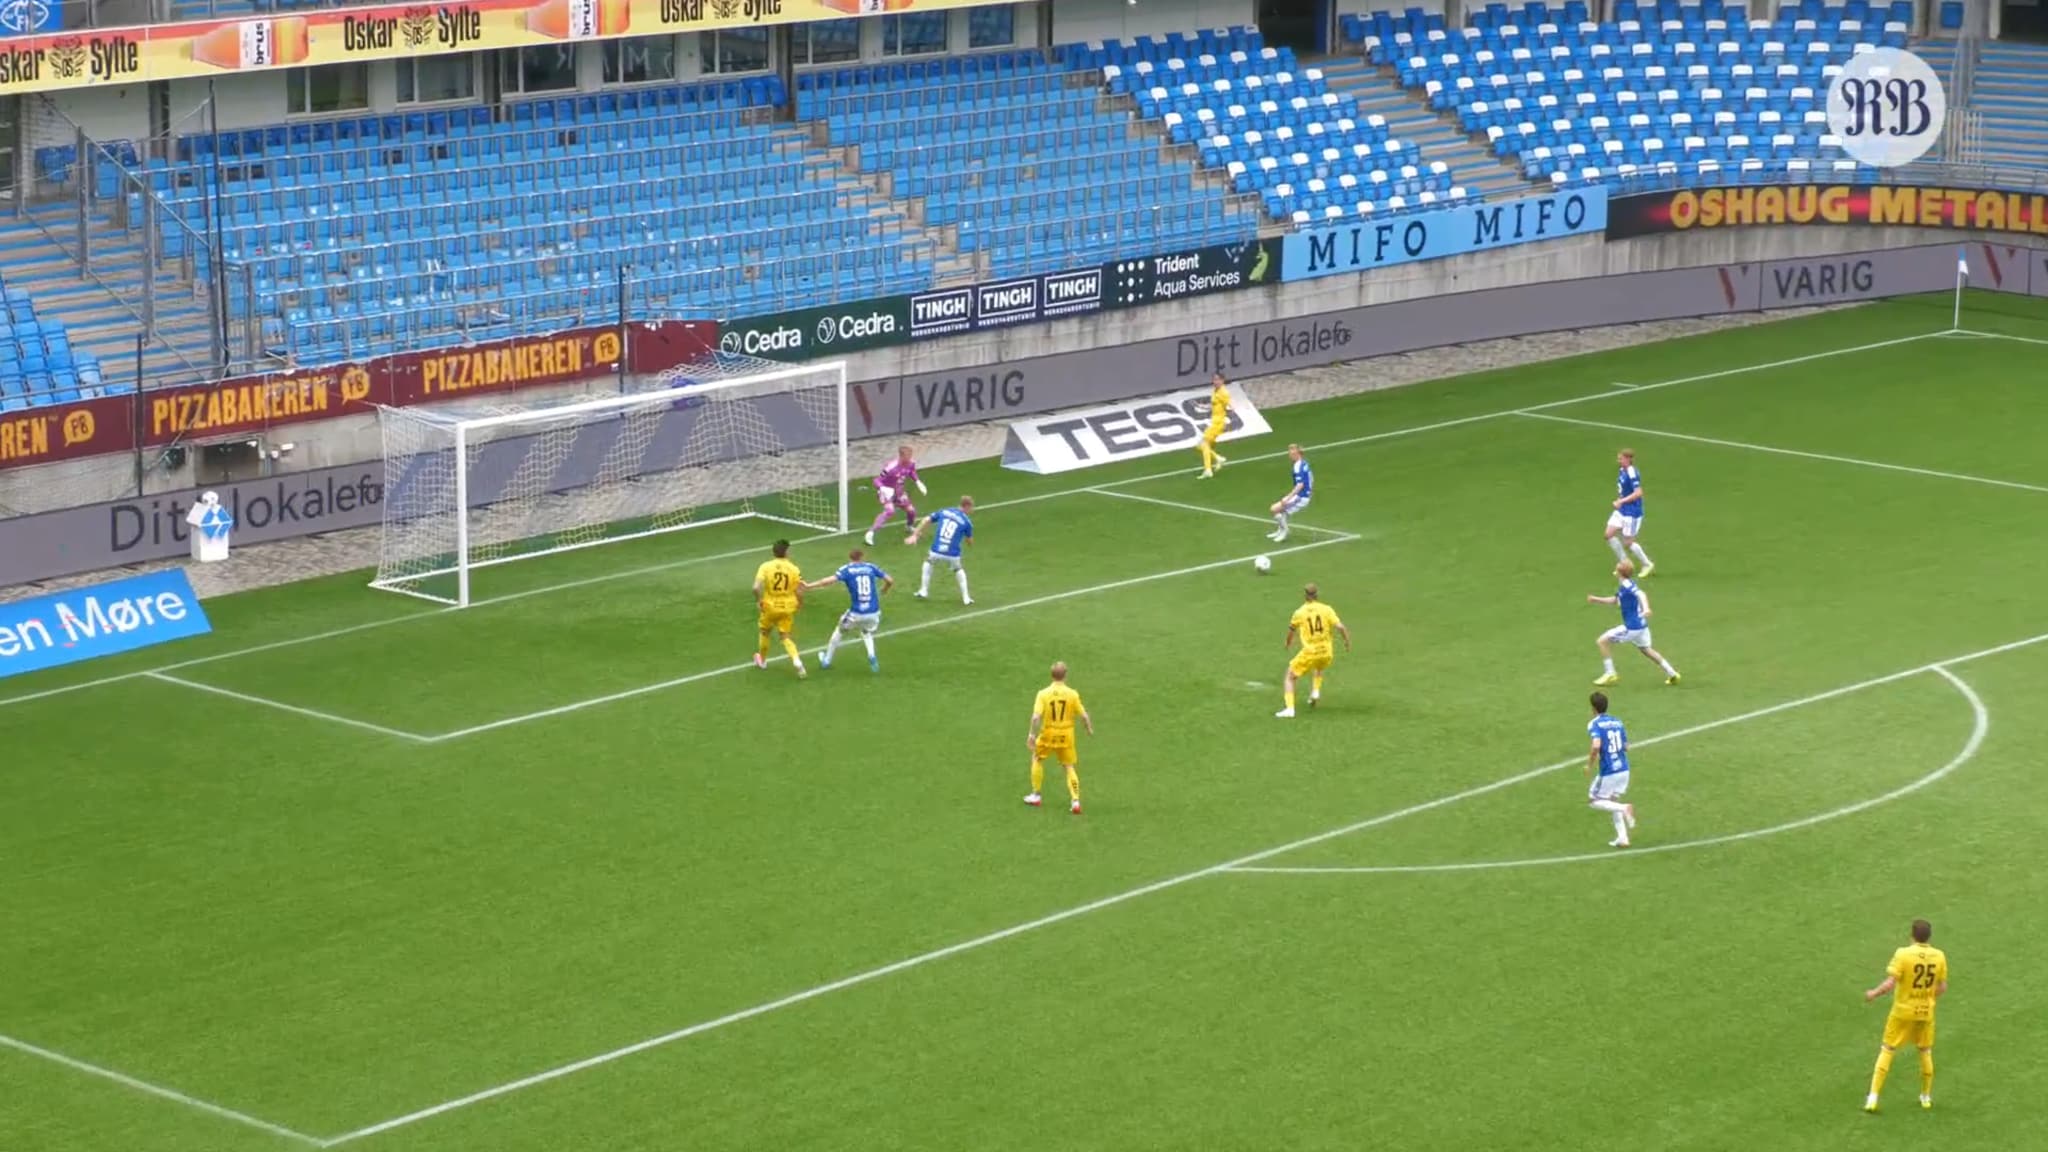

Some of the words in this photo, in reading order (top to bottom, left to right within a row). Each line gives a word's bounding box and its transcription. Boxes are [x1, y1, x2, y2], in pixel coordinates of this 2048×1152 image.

[254, 22, 264, 64] brus
[344, 14, 397, 51] Oskar
[438, 5, 481, 48] Sylte
[91, 37, 138, 80] Sylte
[1669, 186, 1850, 230] OSHAUG
[1869, 186, 2048, 234] METALL
[1308, 220, 1427, 272] MIFO
[1474, 194, 1586, 245] MIFO
[1154, 253, 1200, 275] Trident
[1774, 260, 1874, 299] VARIG
[983, 287, 1032, 310] TINGH
[1049, 277, 1097, 300] TINGH
[1154, 280, 1187, 299] Aqua
[1188, 270, 1241, 290] Services
[839, 312, 895, 339] Cedra
[916, 297, 966, 320] TINGH
[744, 326, 801, 354] Cedra
[1176, 333, 1241, 377] Ditt
[423, 337, 582, 394] PIZZABAKEREN
[153, 375, 328, 435] PIZZABAKEREN
[915, 371, 1025, 420] VARIG
[1038, 395, 1245, 461] TESS
[111, 496, 203, 552] Dit
[773, 572, 789, 591] 21
[55, 592, 187, 641] Møre
[1307, 614, 1324, 636] 14
[1049, 700, 1066, 721] 17
[1607, 729, 1622, 753] 31
[1912, 964, 1936, 989] 25
